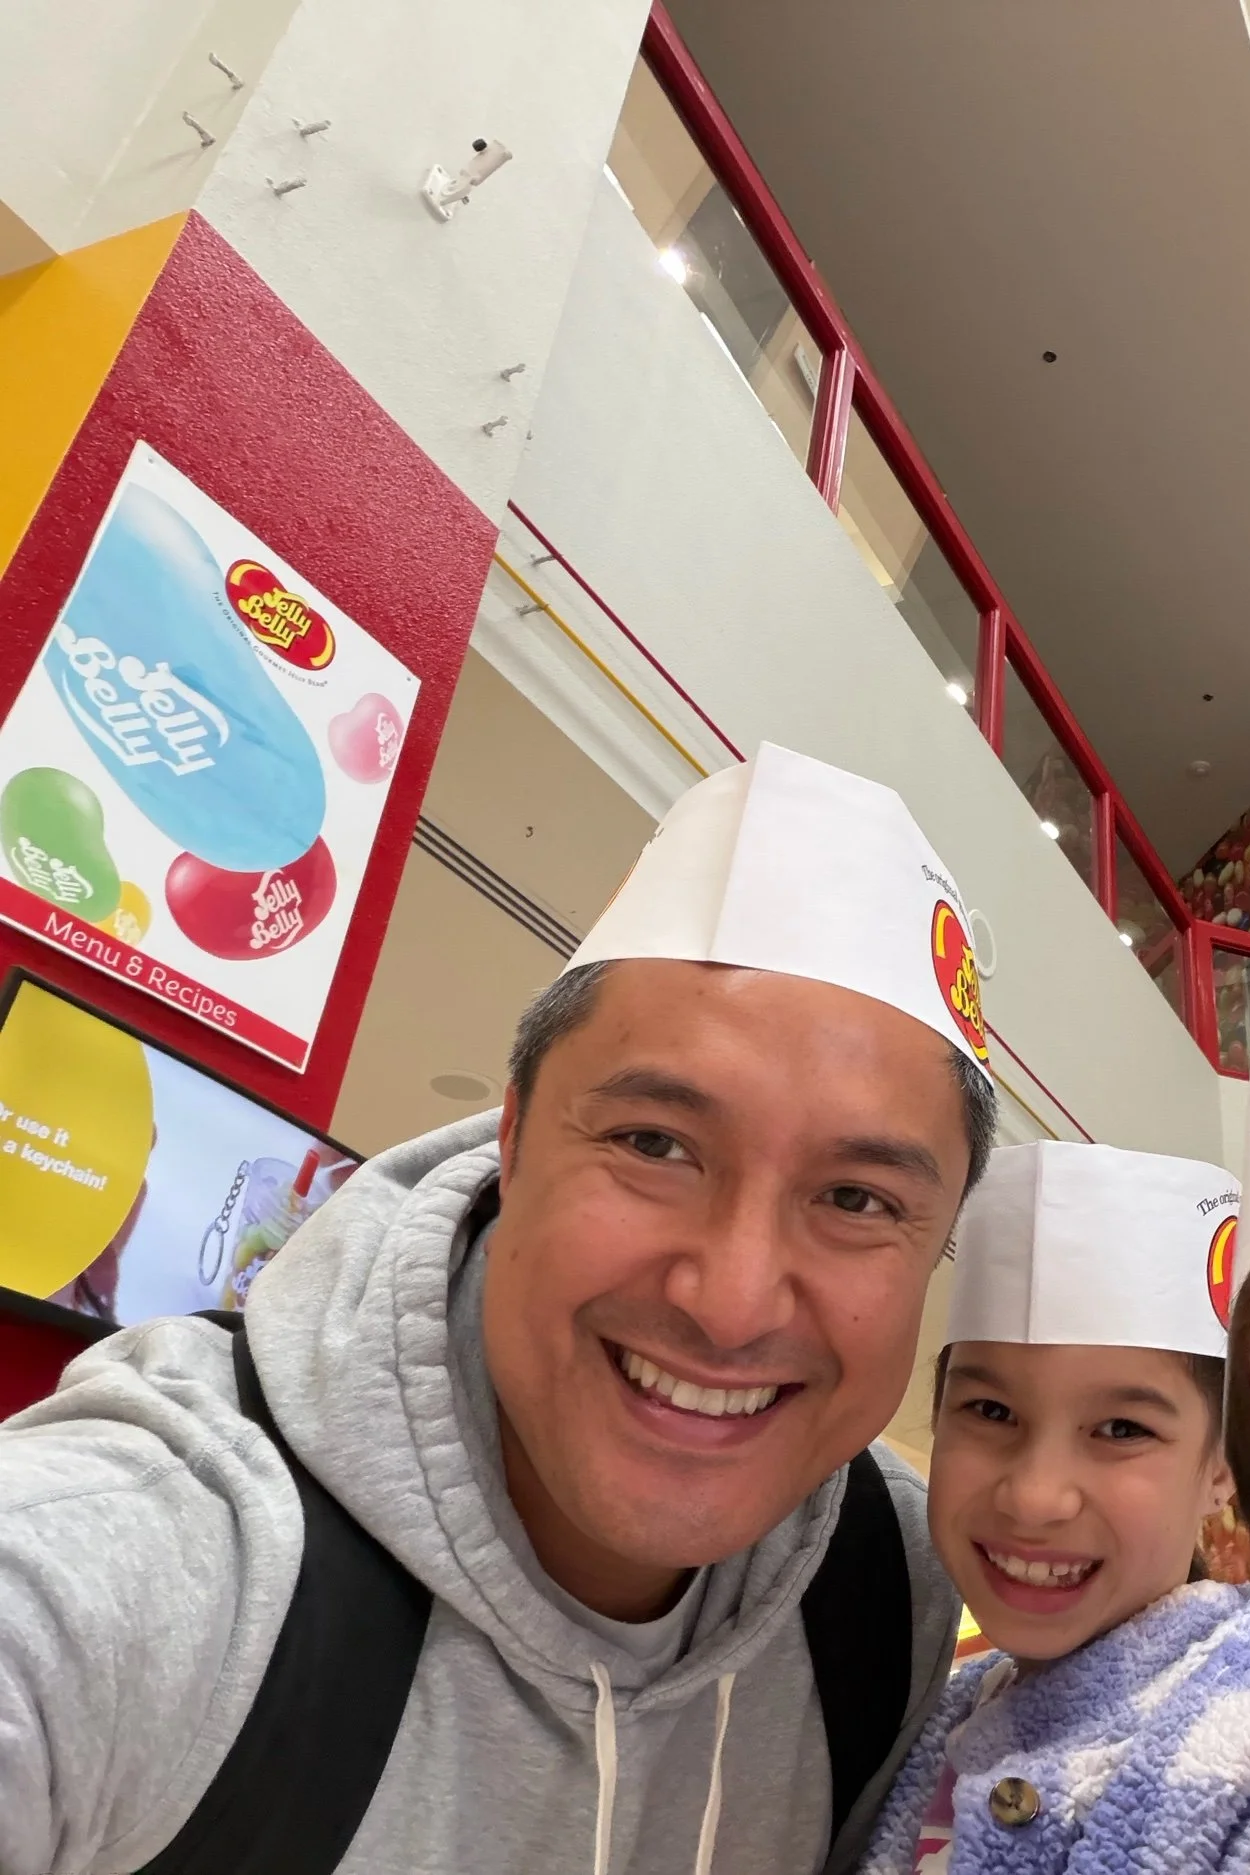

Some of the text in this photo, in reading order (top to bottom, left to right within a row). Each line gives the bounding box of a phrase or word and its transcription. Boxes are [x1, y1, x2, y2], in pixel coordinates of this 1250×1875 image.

[238, 594, 296, 649] Belly
[263, 587, 312, 637] Jelly
[55, 623, 161, 766] Belly
[118, 655, 229, 776] Jelly
[10, 836, 56, 894] Belly
[50, 858, 94, 903] Jelly
[251, 868, 303, 921] Jelly
[249, 907, 304, 950] Belly
[44, 912, 121, 968] Menu
[125, 955, 144, 977] &
[148, 966, 238, 1027] Recipes
[16, 1115, 50, 1139] use
[53, 1127, 69, 1147] it
[2, 1140, 108, 1191] a keychain!
[1196, 1197, 1220, 1216] The
